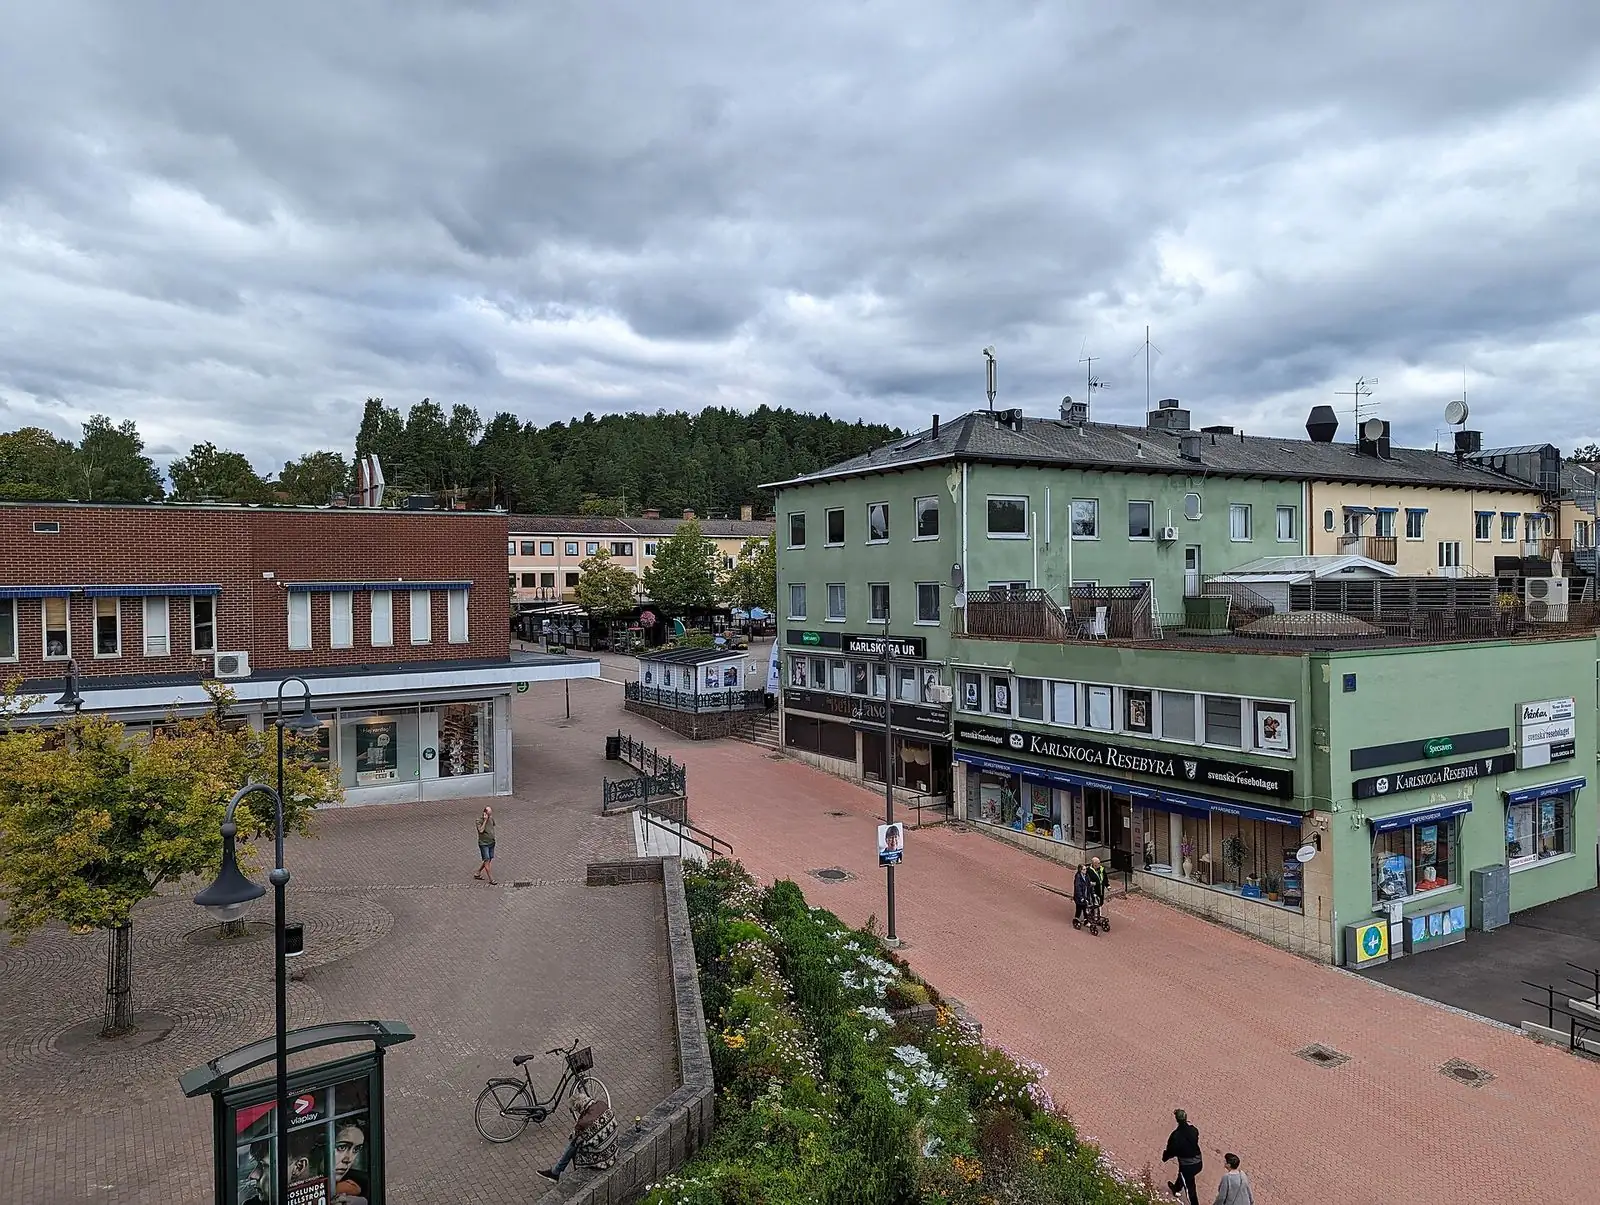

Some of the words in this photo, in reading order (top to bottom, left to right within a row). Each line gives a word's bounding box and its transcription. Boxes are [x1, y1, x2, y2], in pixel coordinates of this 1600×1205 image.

[902, 645, 915, 655] UR
[1429, 743, 1453, 753] Specsavers
[1030, 736, 1102, 764] KARLSKOGA
[1106, 748, 1175, 777] RESEBYRÅ
[1207, 771, 1236, 783] svenska
[1237, 776, 1279, 791] resebolaget
[1395, 773, 1442, 791] KARLSKOGA
[1443, 764, 1479, 783] RESEBYRÅ
[290, 1112, 318, 1125] viaplay
[287, 1185, 319, 1199] OSLUND
